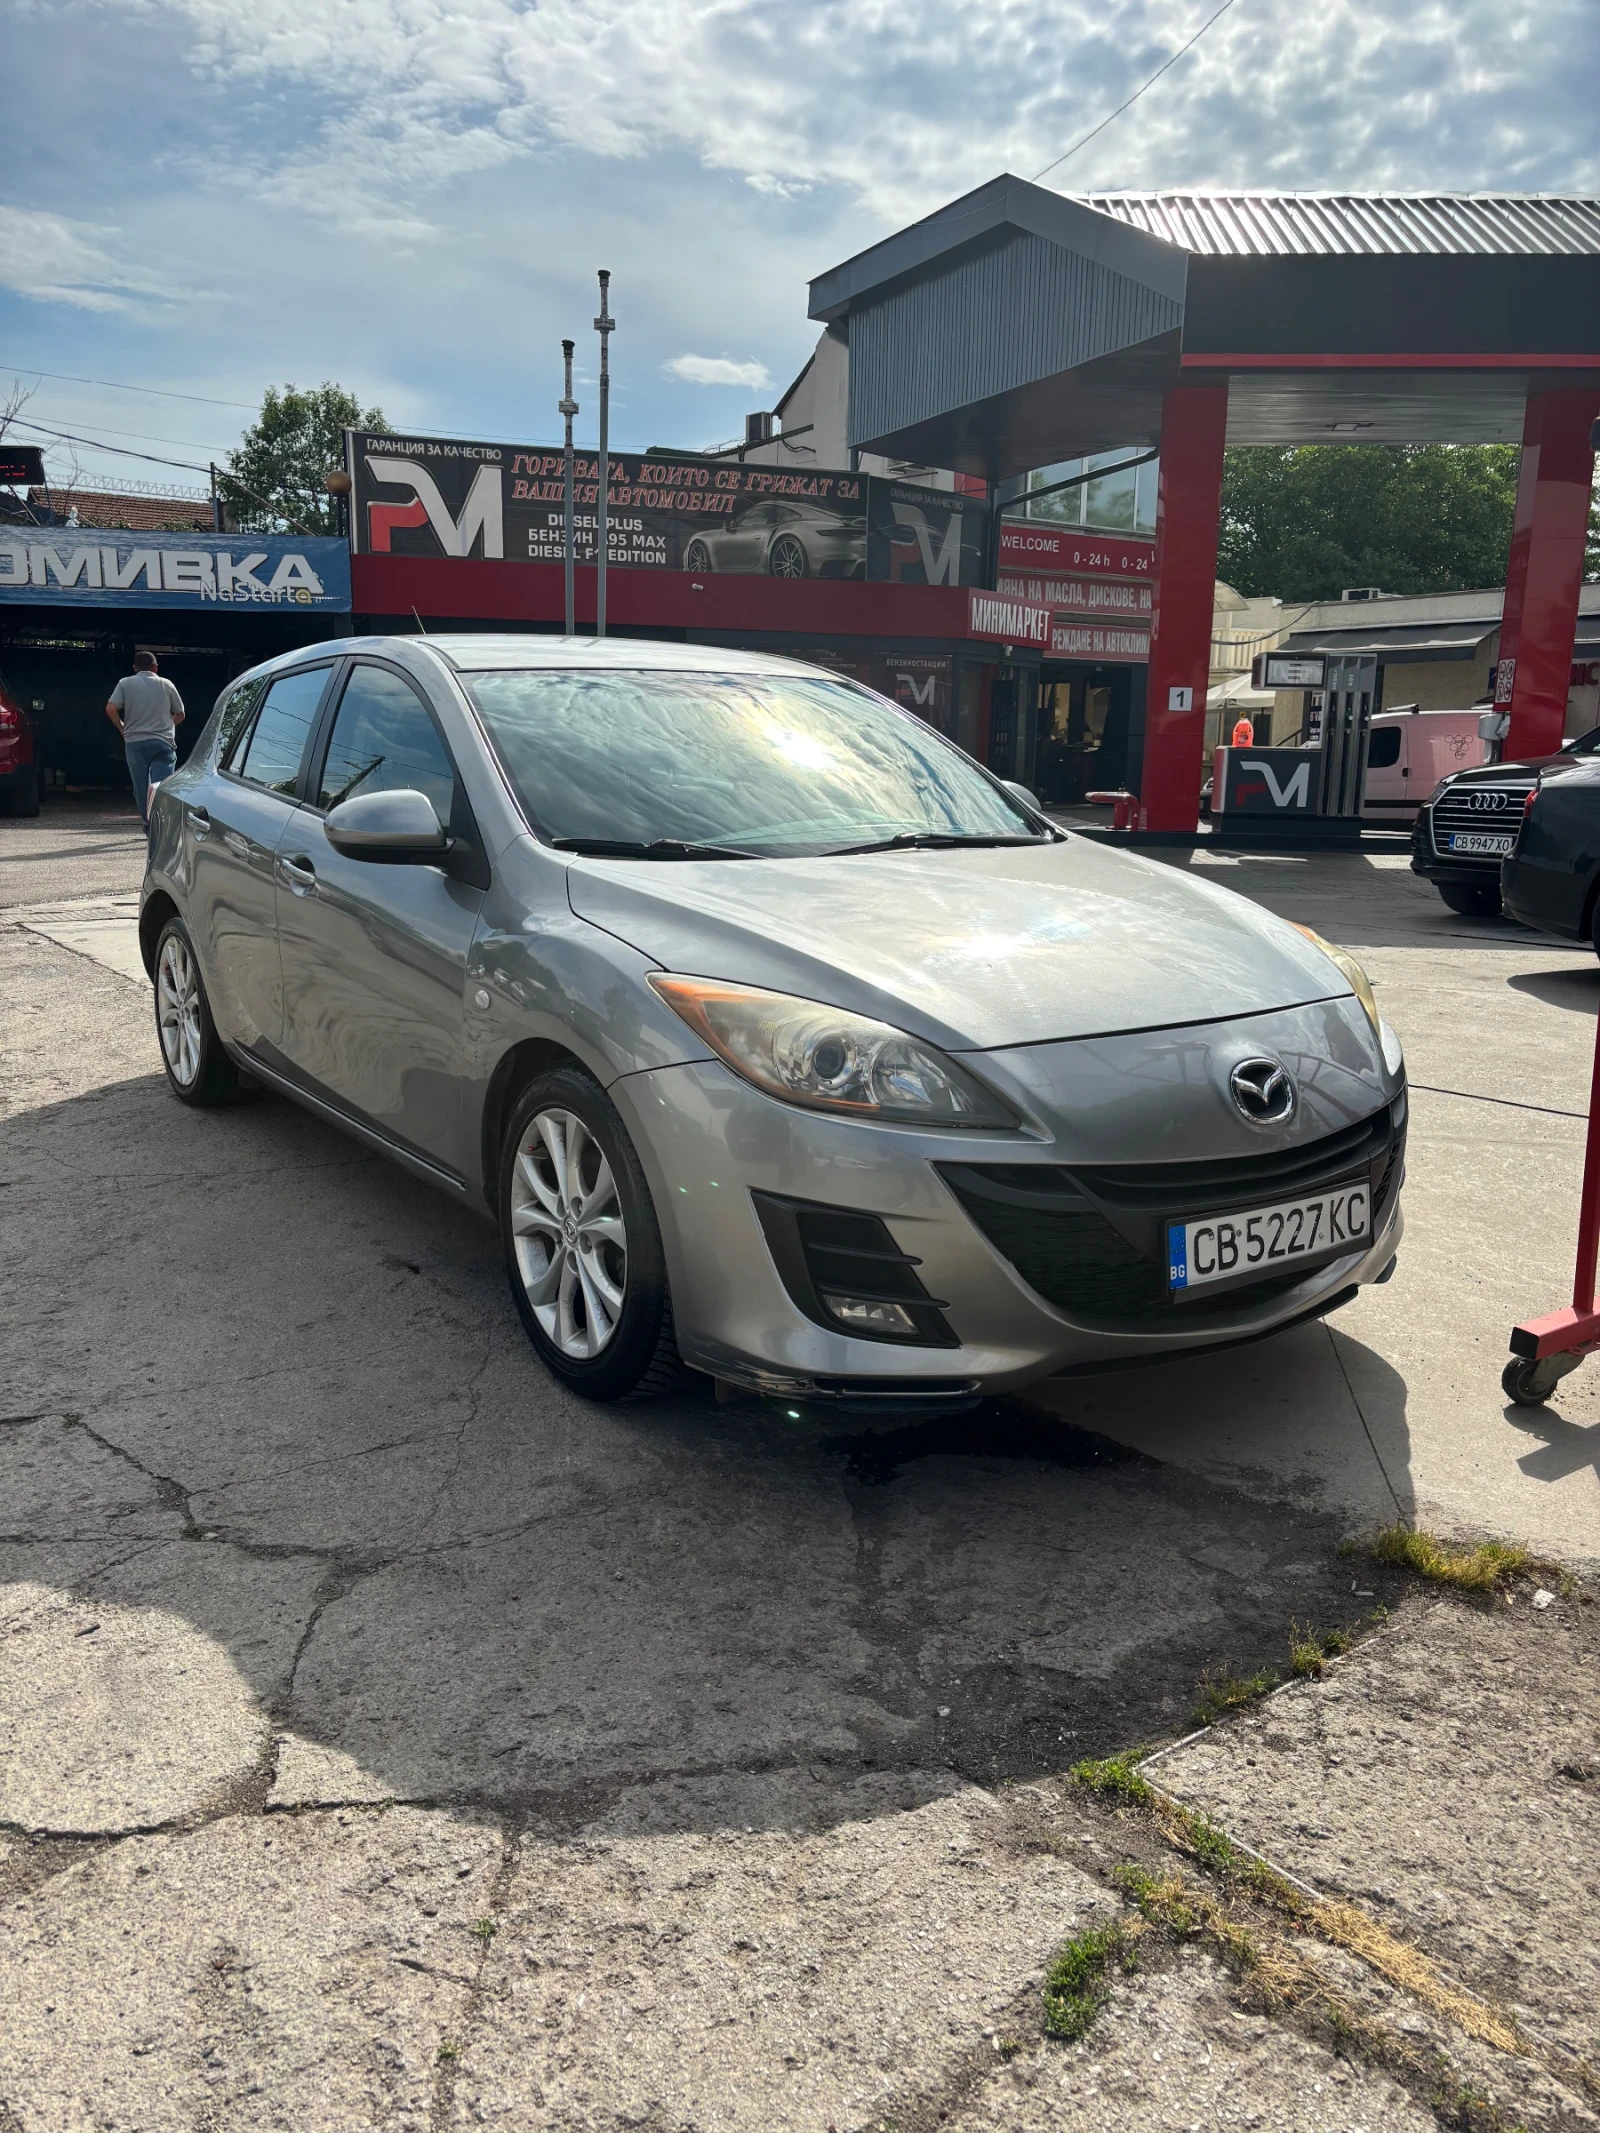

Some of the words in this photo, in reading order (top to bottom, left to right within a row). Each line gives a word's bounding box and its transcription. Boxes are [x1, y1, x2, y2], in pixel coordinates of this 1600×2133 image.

[367, 439, 424, 454] ГАРАНЦИЯ
[427, 444, 442, 455] ЗА
[444, 446, 502, 460] КАЧЕСТВО
[638, 464, 709, 486] КОИТО
[715, 470, 741, 489] СЕ
[745, 473, 833, 496] ГРИЖАТ
[837, 481, 860, 499] ЗА
[511, 480, 600, 503] ВАШИЯ
[606, 486, 736, 513] АВТОМОБИЛ
[548, 514, 600, 529] DISEL
[606, 517, 643, 531] PLUS
[528, 528, 593, 544] БЕНЗИН
[604, 533, 627, 546] 95
[632, 535, 666, 548] MAX
[1001, 535, 1060, 552] WELCOME
[528, 545, 581, 559] DIESL
[608, 550, 666, 564] EDITION
[1089, 554, 1101, 566] 24
[1103, 555, 1110, 567] h
[1136, 559, 1148, 570] 24
[1028, 580, 1042, 601] НА
[1045, 581, 1086, 607] МАСЛА,
[1088, 585, 1137, 610] ДИСКОВЕ,
[971, 597, 1050, 641] МИНИМАРКЕТ
[1052, 628, 1091, 653] РЕЖДАНЕ
[1093, 631, 1104, 652] НА
[1176, 690, 1184, 708] 1
[1455, 837, 1468, 849] CB
[1470, 837, 1494, 850] 9947
[1193, 1223, 1238, 1275] CB
[1246, 1202, 1323, 1263] 5227
[1329, 1192, 1365, 1243] KC
[1170, 1264, 1186, 1281] BG
